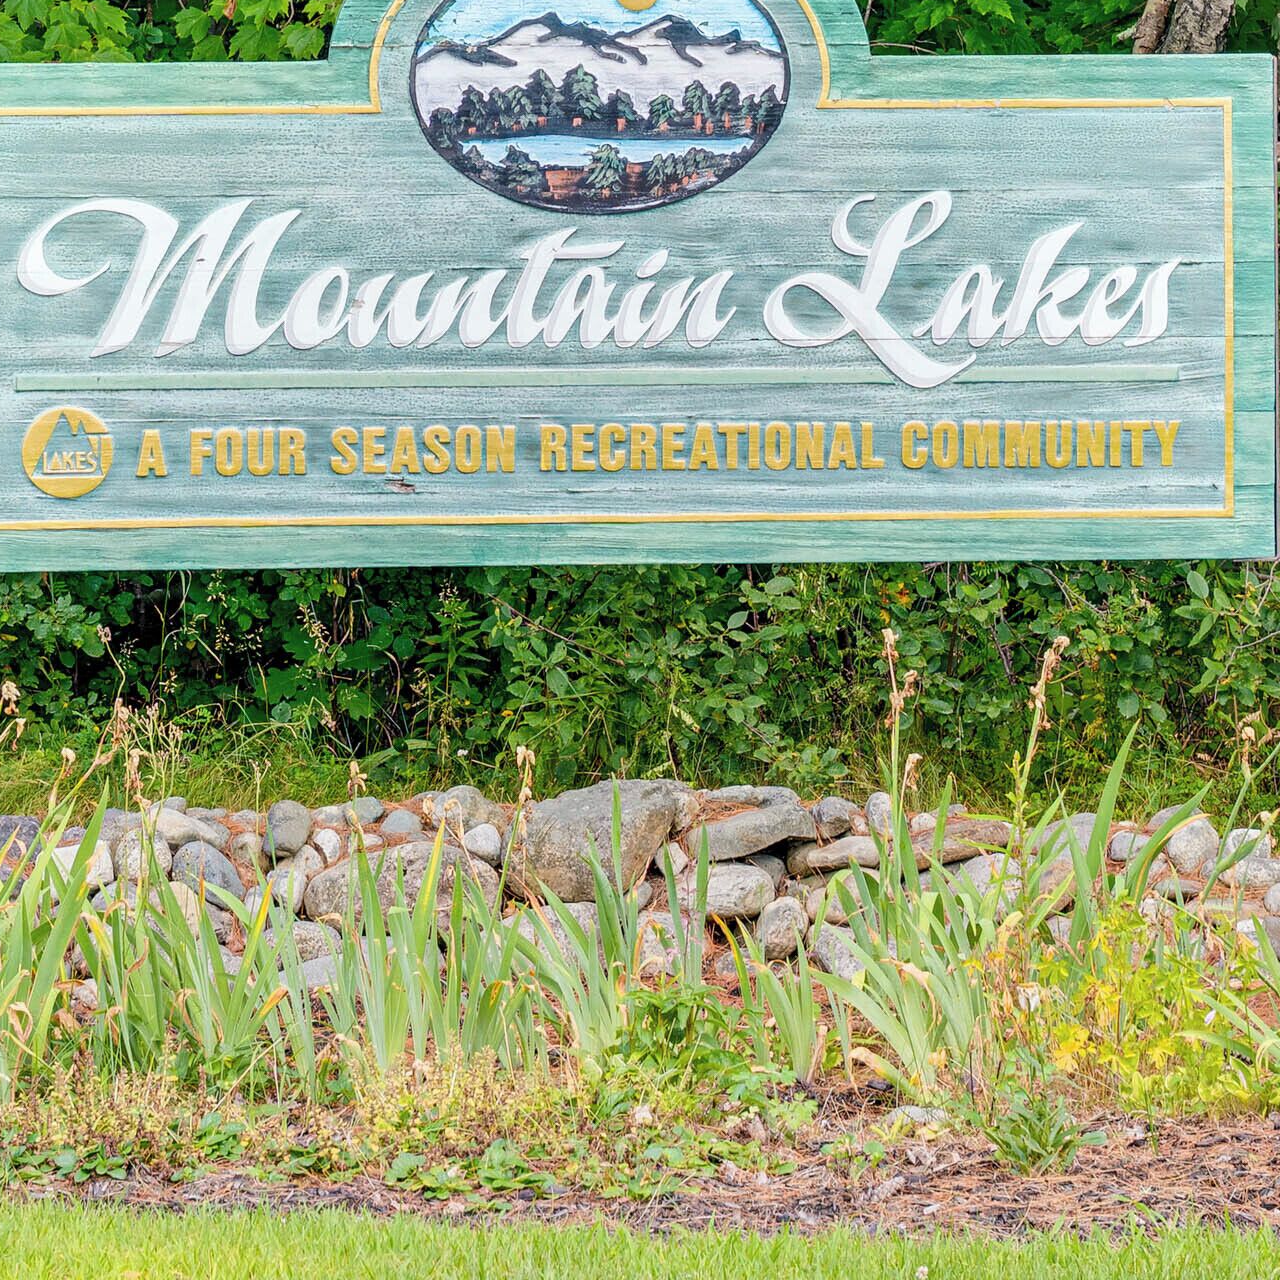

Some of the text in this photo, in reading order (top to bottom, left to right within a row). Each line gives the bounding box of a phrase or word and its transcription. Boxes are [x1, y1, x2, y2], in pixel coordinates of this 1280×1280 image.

[17, 190, 1184, 389] Mountain Lakes
[42, 451, 98, 475] LAKES
[137, 419, 1182, 478] A FOUR SEASON RECREATIONAL COMMUNITY
